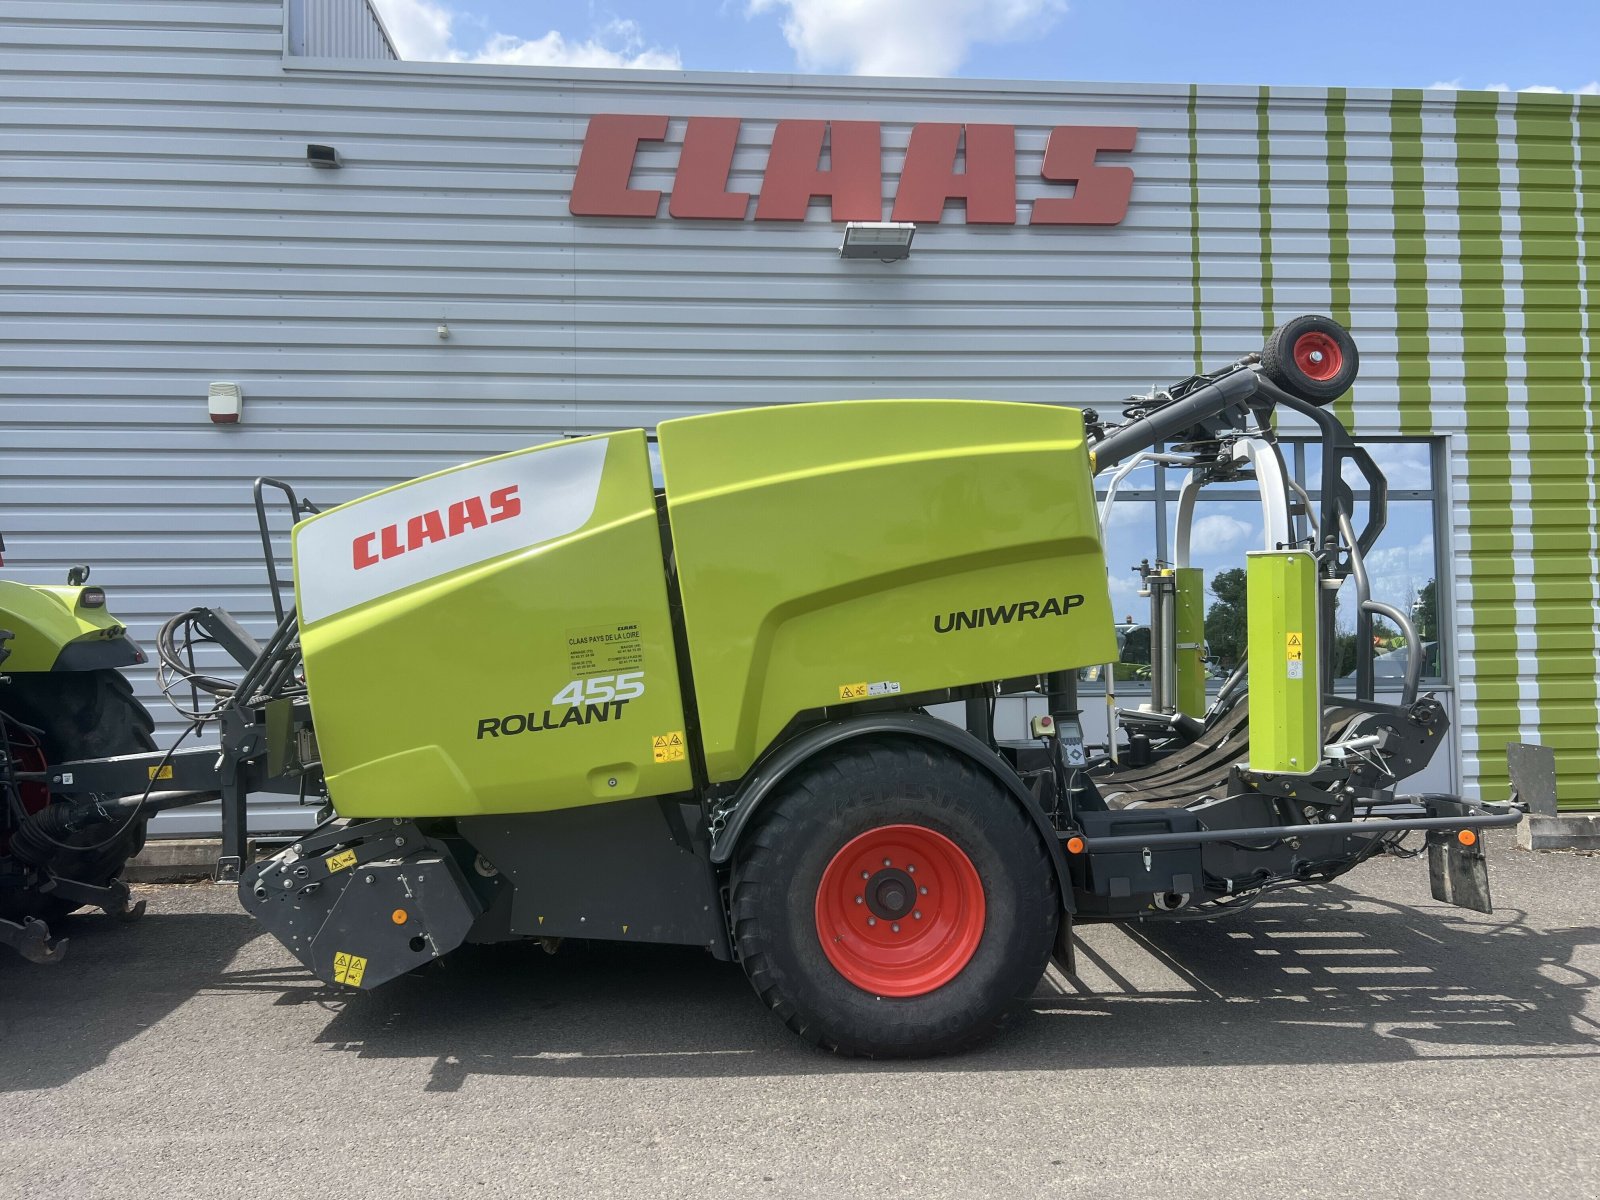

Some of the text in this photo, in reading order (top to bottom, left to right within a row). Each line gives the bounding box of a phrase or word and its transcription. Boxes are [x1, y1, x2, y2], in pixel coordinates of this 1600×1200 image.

[569, 114, 1138, 226] CLAAS
[353, 485, 521, 570] CLAAS
[934, 594, 1085, 633] UNIWRAP
[569, 637, 588, 645] CLAAS
[589, 635, 604, 643] PAYS
[614, 632, 622, 640] LA
[623, 631, 640, 639] LOIRE
[552, 671, 645, 707] 455
[477, 699, 629, 739] ROLLANT
